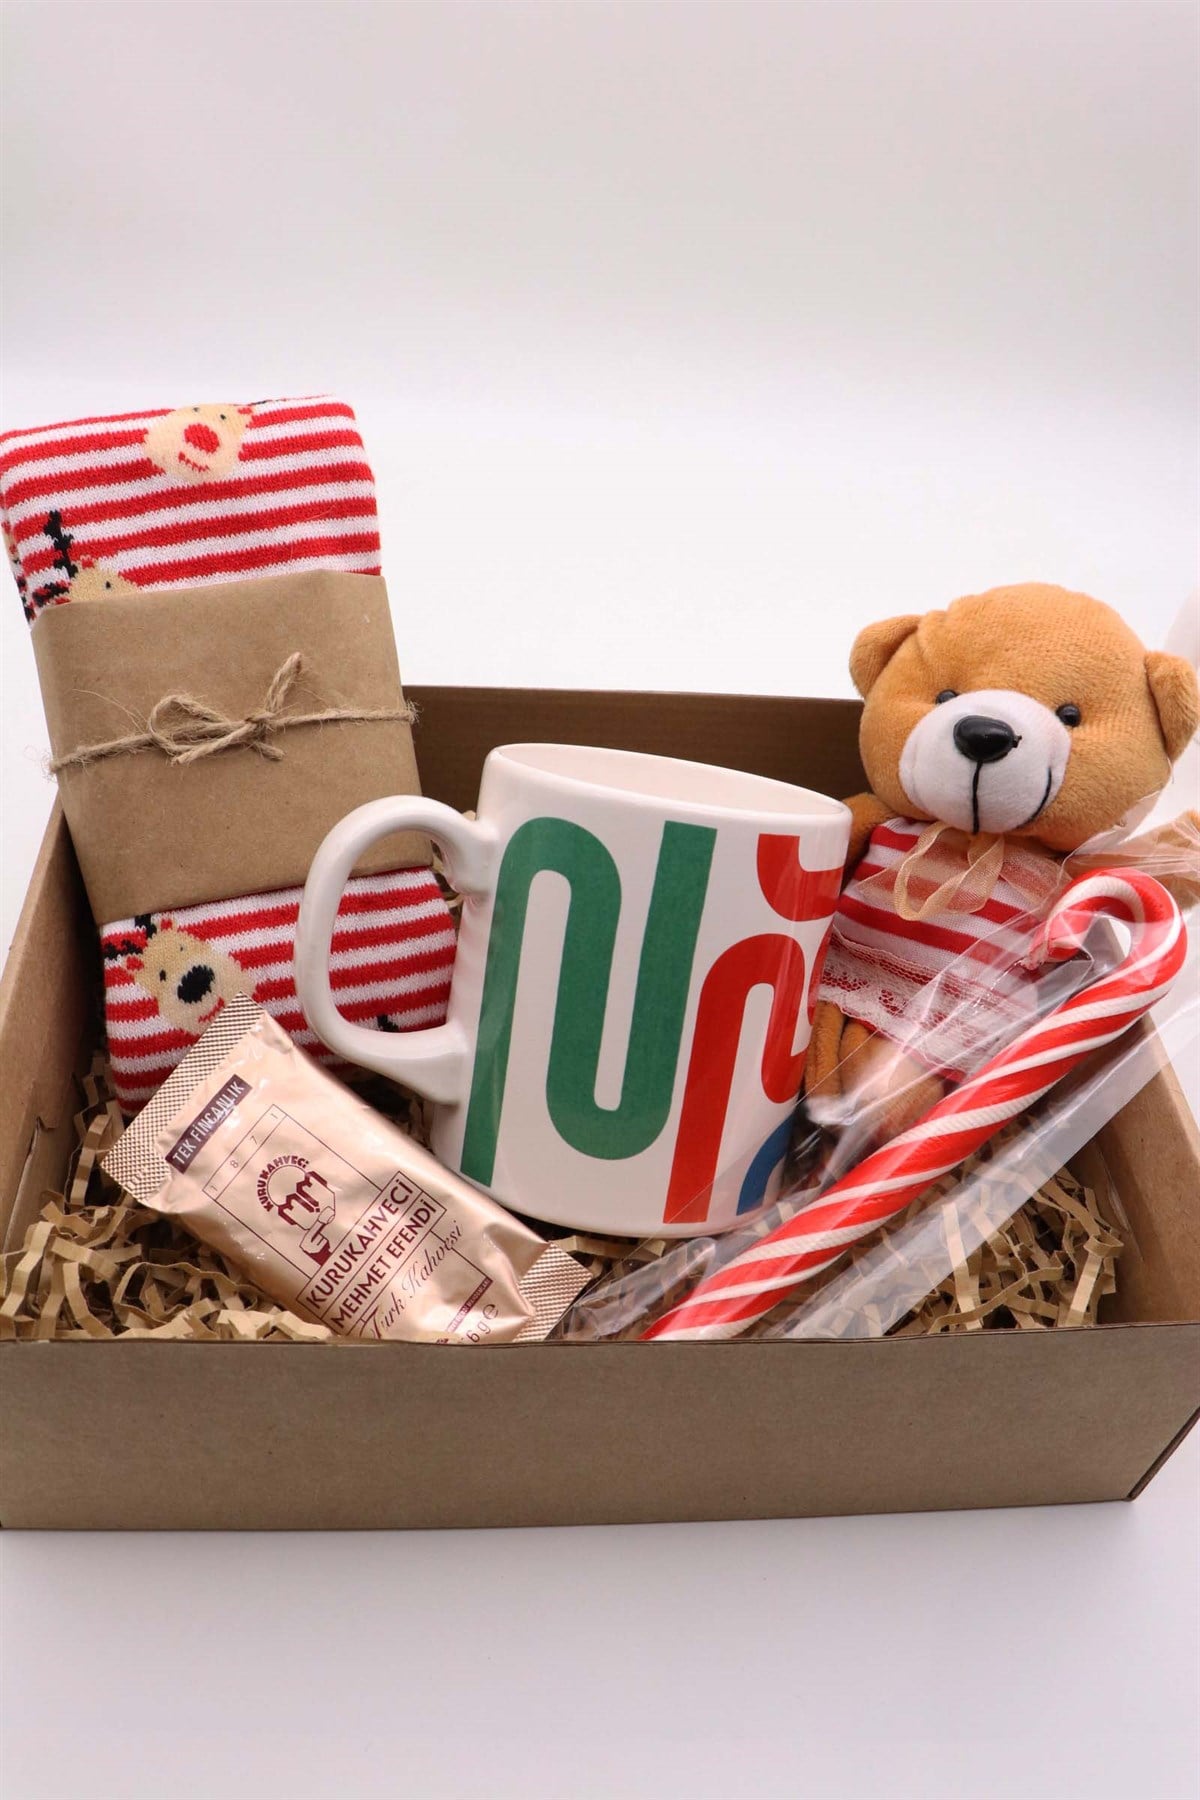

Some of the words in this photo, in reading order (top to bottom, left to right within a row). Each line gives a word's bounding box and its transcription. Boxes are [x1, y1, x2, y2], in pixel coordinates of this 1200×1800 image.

[172, 1139, 197, 1165] TEK
[190, 1081, 245, 1142] FİNCANLIK
[306, 1179, 414, 1310] KURUKAHVECİ
[331, 1255, 392, 1329] MEHMET
[385, 1198, 438, 1260] EFENDİ
